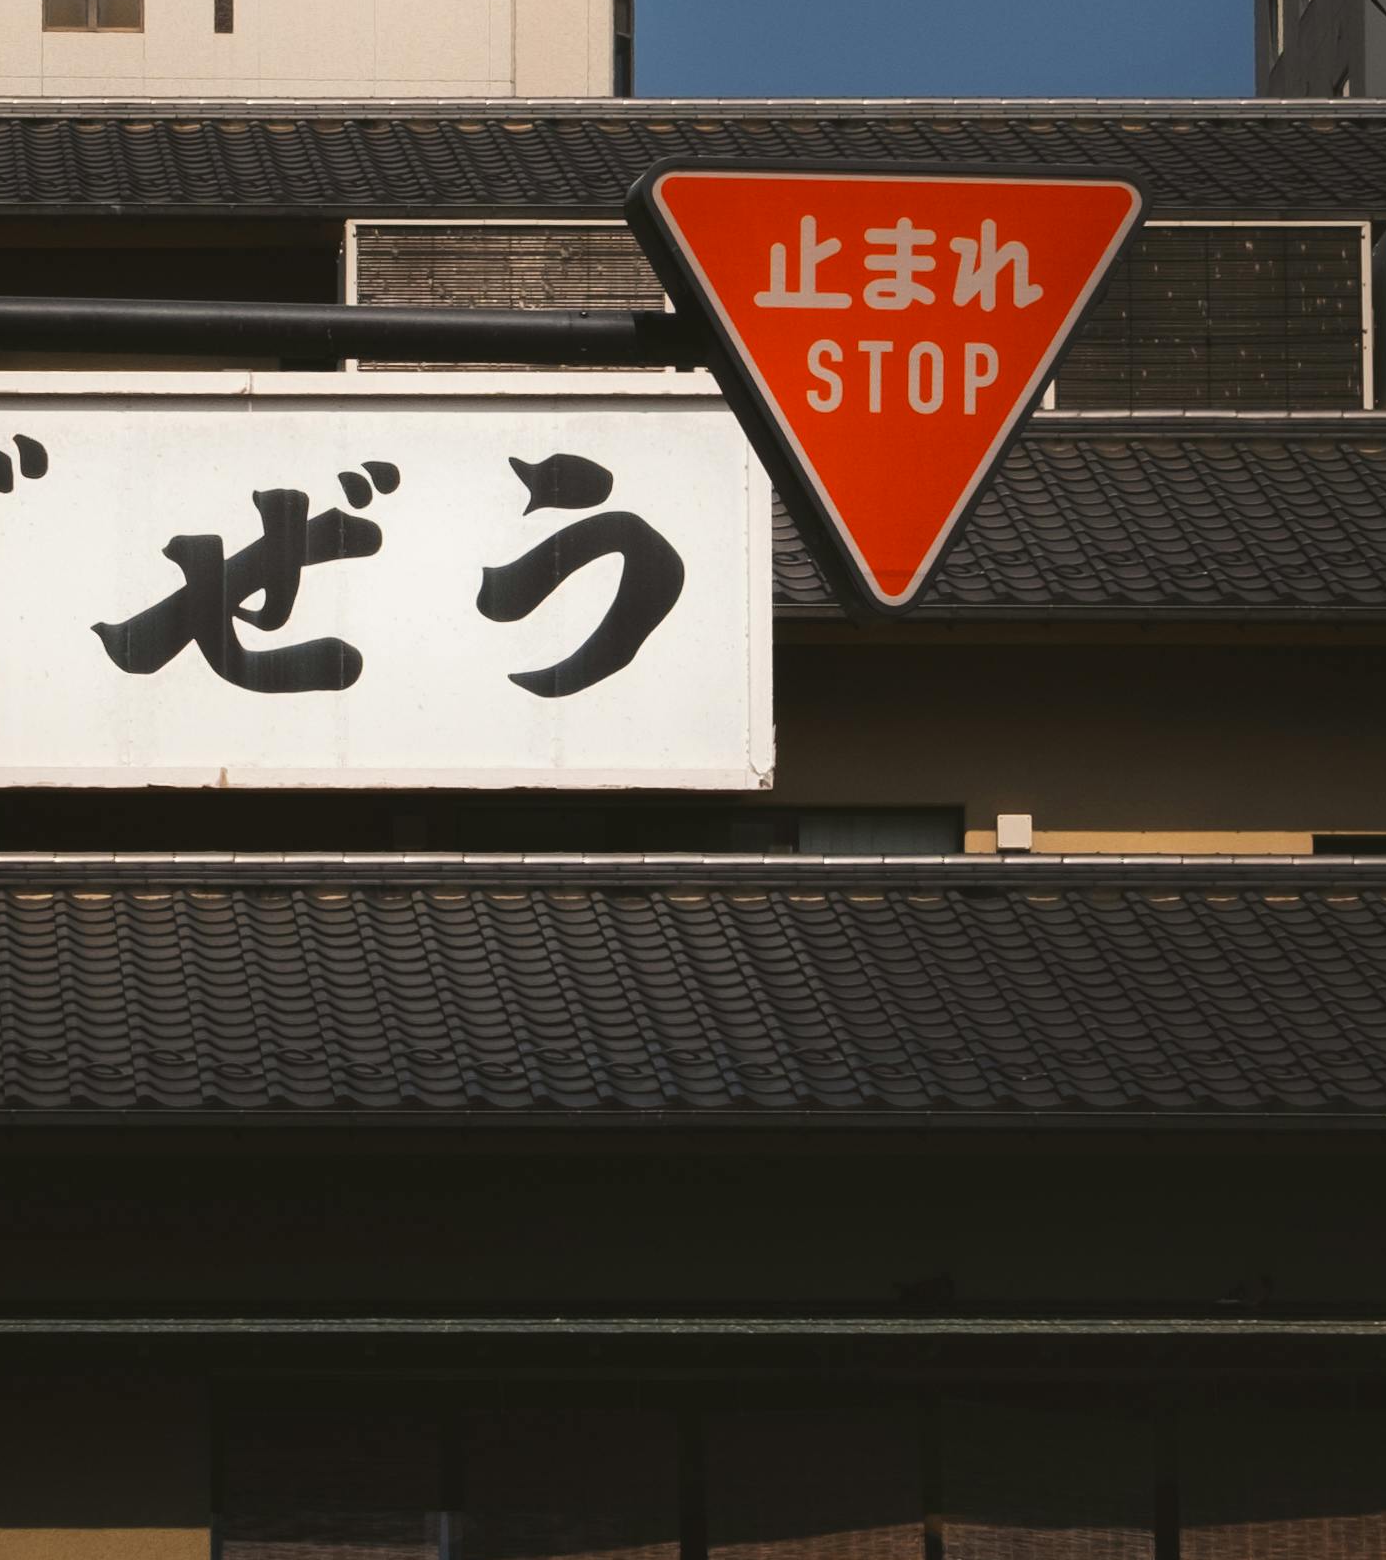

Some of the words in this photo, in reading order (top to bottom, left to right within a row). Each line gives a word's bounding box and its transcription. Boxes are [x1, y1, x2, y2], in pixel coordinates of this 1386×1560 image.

[754, 215, 1045, 314] 止まれ
[804, 339, 1001, 415] STOP
